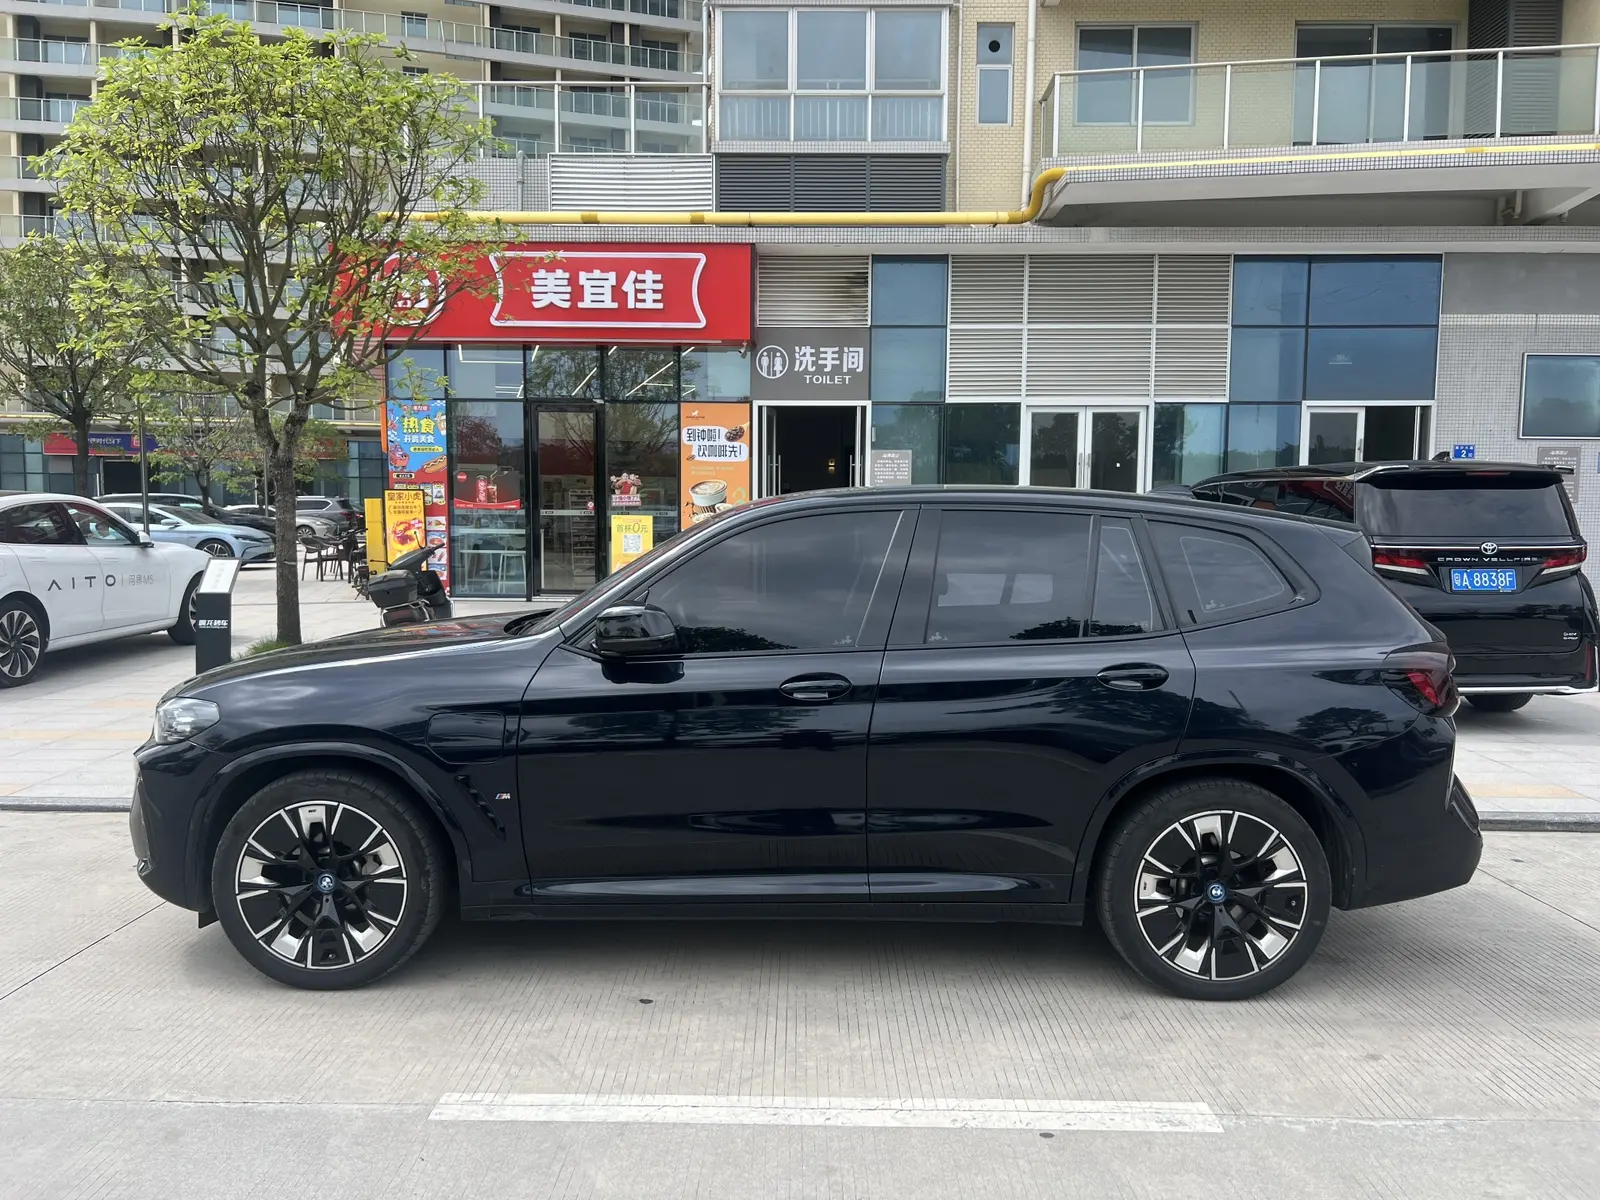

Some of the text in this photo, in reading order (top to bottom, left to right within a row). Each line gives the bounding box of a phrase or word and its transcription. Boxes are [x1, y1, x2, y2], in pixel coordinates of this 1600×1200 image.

[531, 269, 664, 309] 美宜佳
[794, 345, 864, 372] 洗手间
[804, 375, 852, 385] TOILET
[402, 416, 436, 434] 热食
[387, 492, 422, 501] 皇家小虎
[616, 522, 649, 533] 首杯0元
[47, 574, 117, 592] AITO
